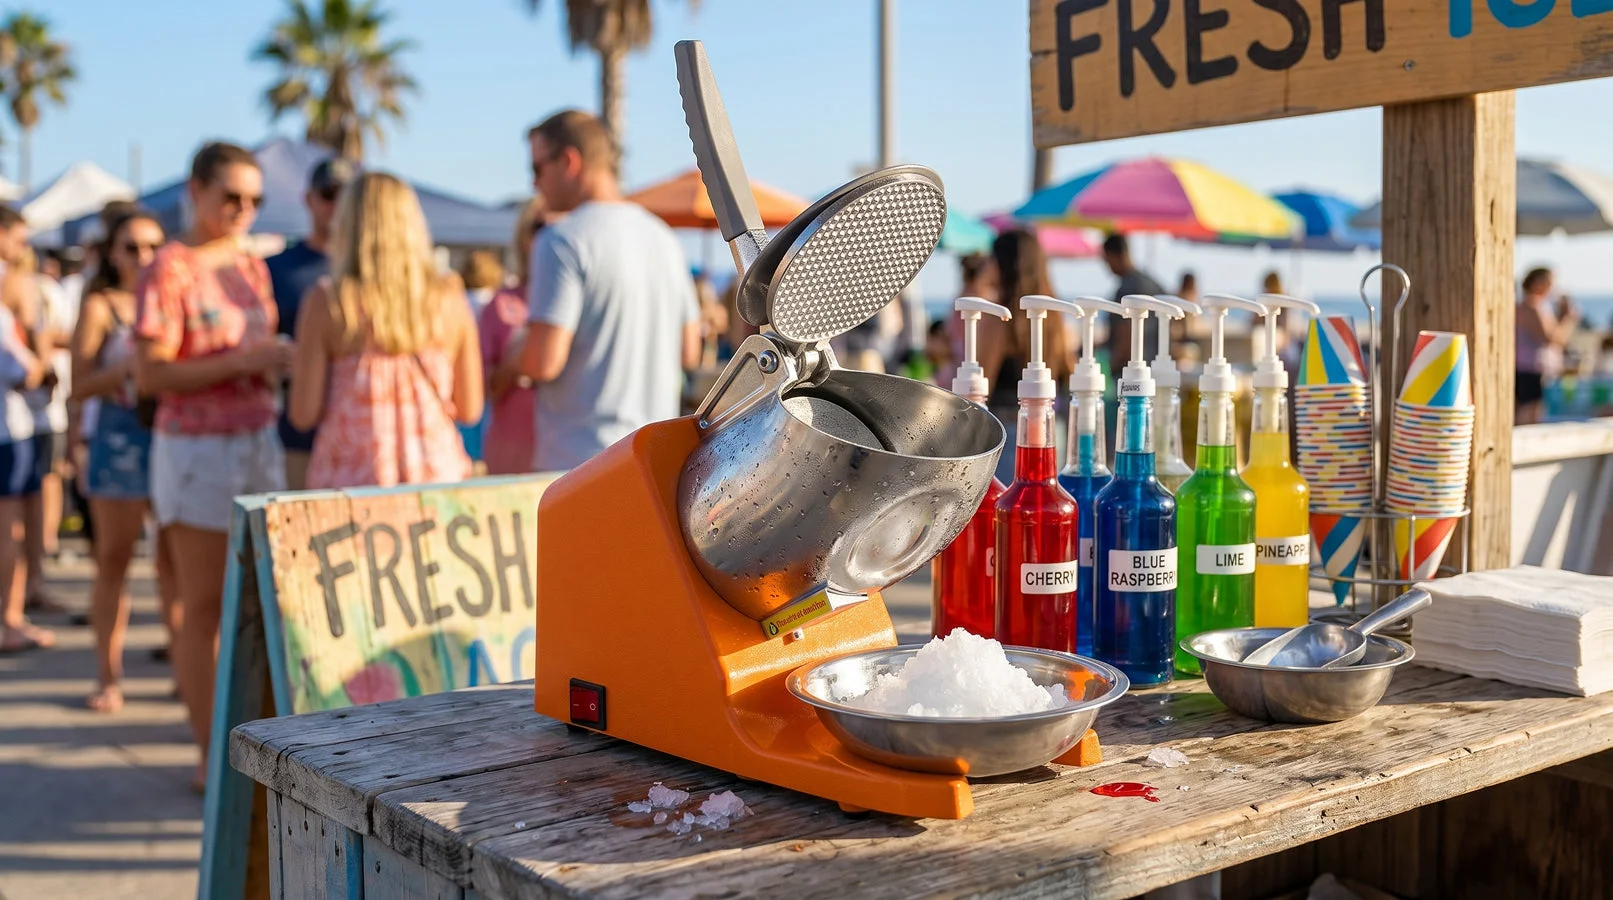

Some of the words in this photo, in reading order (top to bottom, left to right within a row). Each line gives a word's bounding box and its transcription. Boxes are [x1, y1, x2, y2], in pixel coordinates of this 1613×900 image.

[1256, 543, 1309, 558] PINEAPP
[1133, 554, 1166, 569] BLUE
[1216, 553, 1244, 567] LIME
[309, 511, 534, 638] FRESH
[1025, 570, 1075, 586] CHERRY
